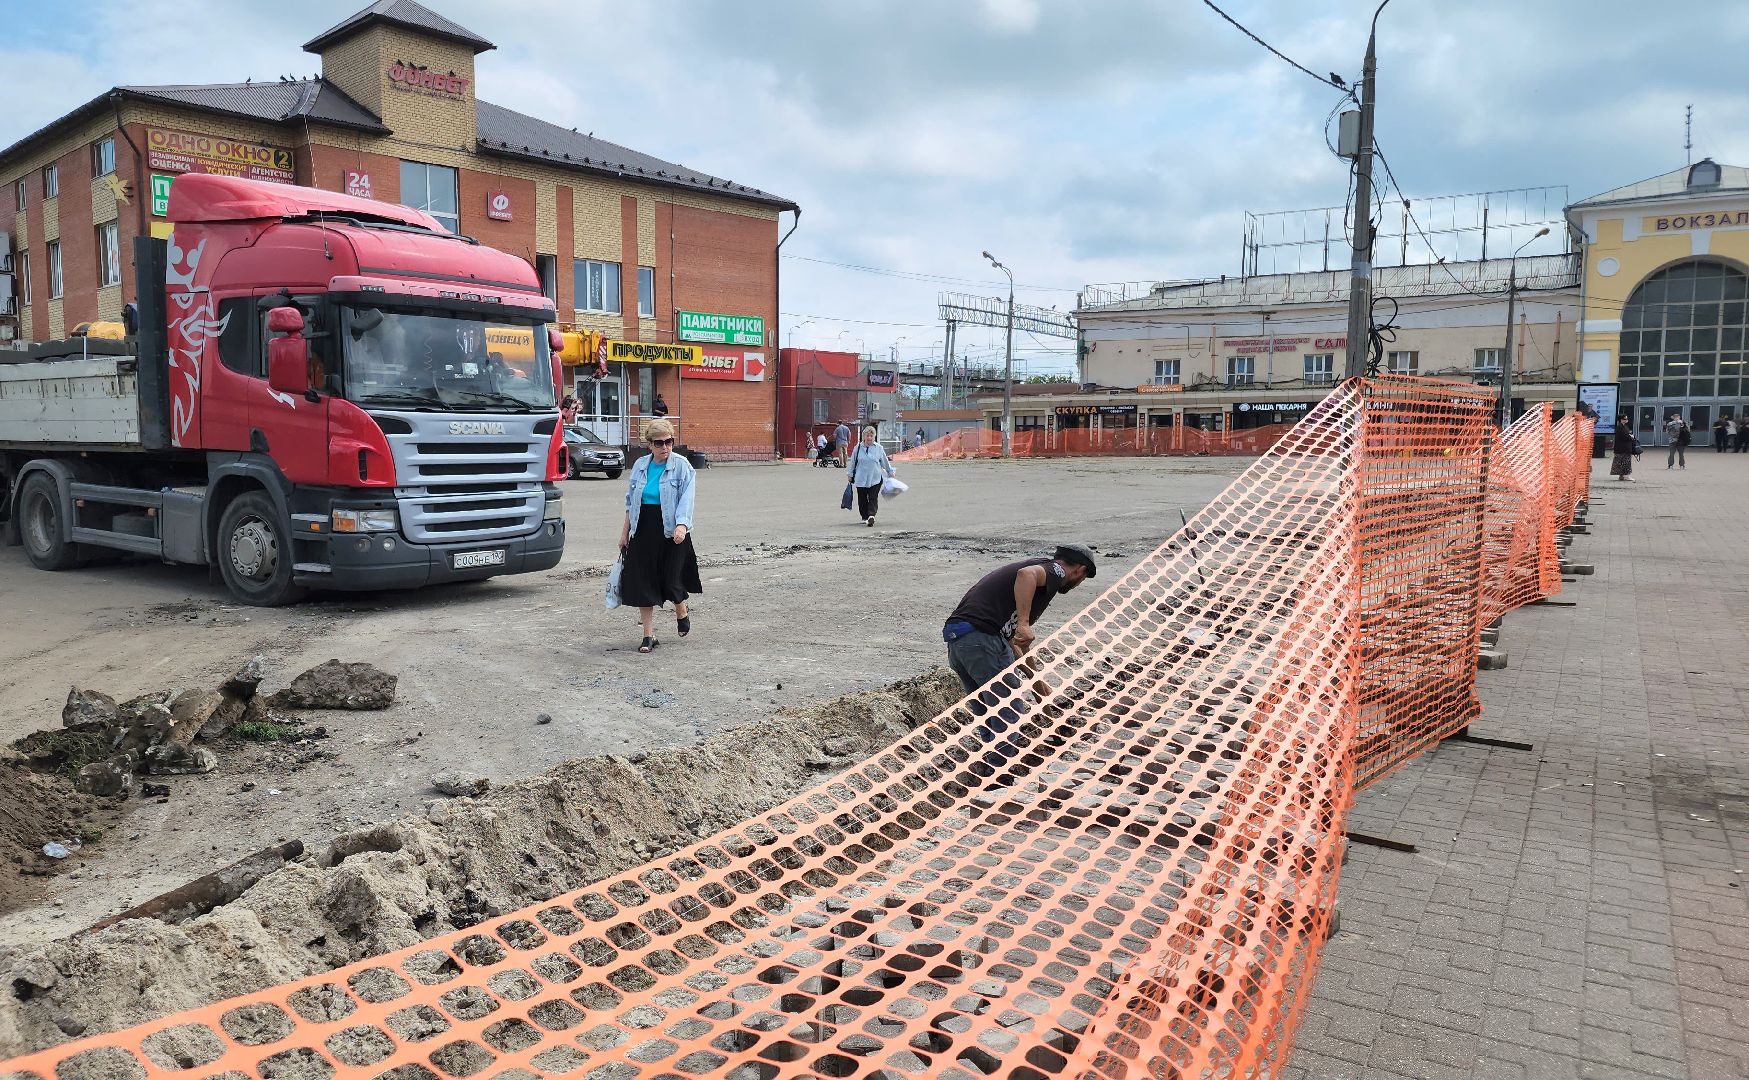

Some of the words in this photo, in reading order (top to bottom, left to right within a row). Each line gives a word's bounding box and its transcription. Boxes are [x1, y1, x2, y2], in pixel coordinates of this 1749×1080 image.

[389, 64, 470, 95] ФОНБЕТ
[151, 130, 211, 152] ОДНО
[216, 141, 272, 162] ОКНО
[151, 159, 191, 171] ОЦЕНКА
[197, 158, 247, 171] ЮРИДИЧЕСКИЕ
[278, 152, 289, 165] 2
[206, 165, 240, 177] УСЛУГИ
[251, 166, 294, 179] АГЕНТСТВО
[350, 172, 371, 189] 24
[350, 187, 371, 198] ЧАСА
[1657, 212, 1749, 230] ВОКЗАЛ
[682, 314, 762, 333] ПАМЯТНИКИ
[744, 335, 760, 344] ВХОД
[612, 342, 694, 361] ПРОДУКТЫ
[702, 355, 738, 369] ОНБЕТ
[1056, 406, 1098, 415] СКУПКА
[1252, 403, 1274, 411] НАША
[1275, 403, 1307, 411] ПЕКАРНЯ
[448, 421, 506, 435] SCANIA
